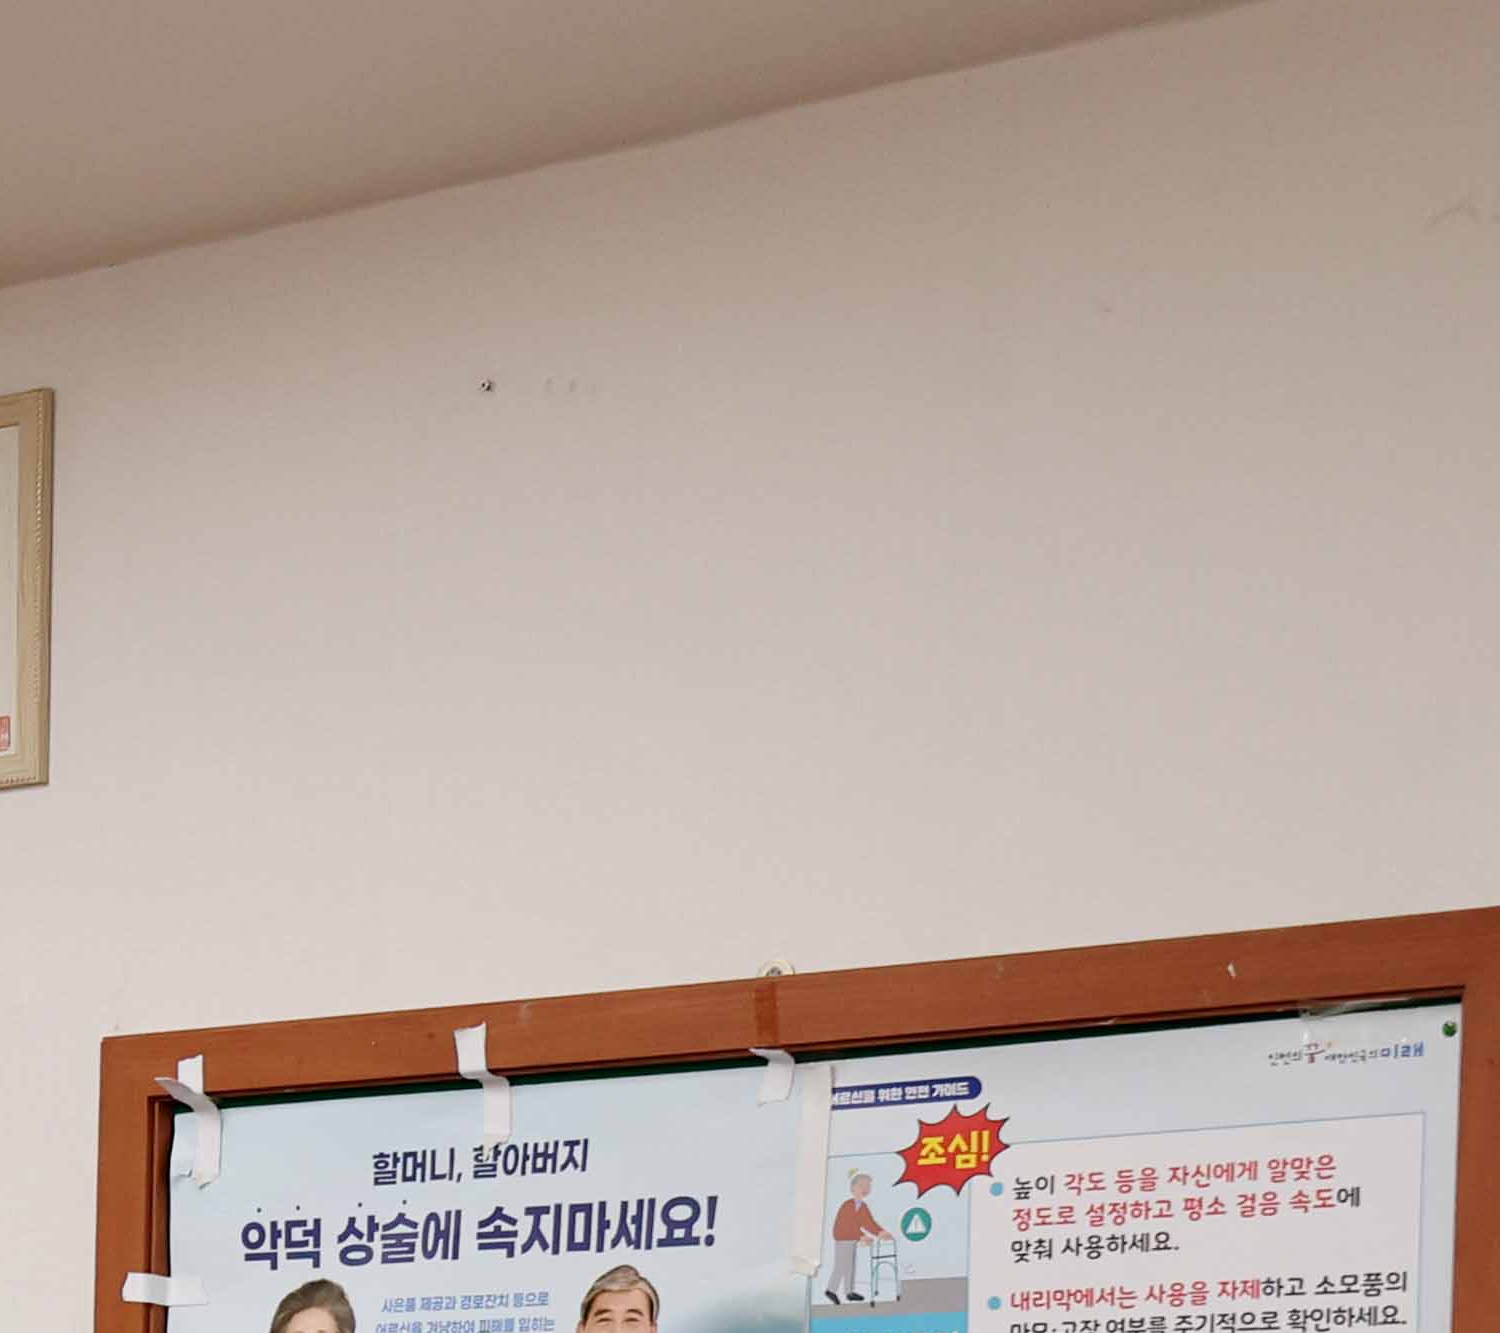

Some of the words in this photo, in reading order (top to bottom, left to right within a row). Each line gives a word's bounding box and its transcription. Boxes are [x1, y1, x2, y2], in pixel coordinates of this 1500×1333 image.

[932, 1082, 970, 1097] 가이드
[373, 1148, 462, 1186] 할머니,
[473, 1138, 588, 1179] 할아버지
[917, 1130, 990, 1169] 조심!
[1013, 1175, 1054, 1200] 높이
[1064, 1172, 1106, 1196] 각도
[1115, 1167, 1159, 1194] 등을
[1167, 1161, 1258, 1188] 자신에게
[1268, 1155, 1336, 1183] 알맞은
[1012, 1206, 1076, 1232] 정도로
[1086, 1200, 1174, 1227] 설정하고
[1183, 1197, 1226, 1221] 평소
[1237, 1192, 1280, 1218] 걸음
[1290, 1187, 1360, 1213] 속도에
[242, 1218, 321, 1270] 악덕
[337, 1210, 462, 1266] 상술에
[476, 1196, 718, 1258] 속지마세요!
[1012, 1239, 1052, 1263] 맞춰
[1062, 1232, 1179, 1259] 사용하세요.
[1011, 1286, 1137, 1311] 내리막에서는
[1145, 1281, 1209, 1307] 사용을
[1218, 1277, 1306, 1300] 자제하고
[1315, 1272, 1407, 1297] 소모품의
[1287, 1305, 1407, 1332] 확인하세요.
